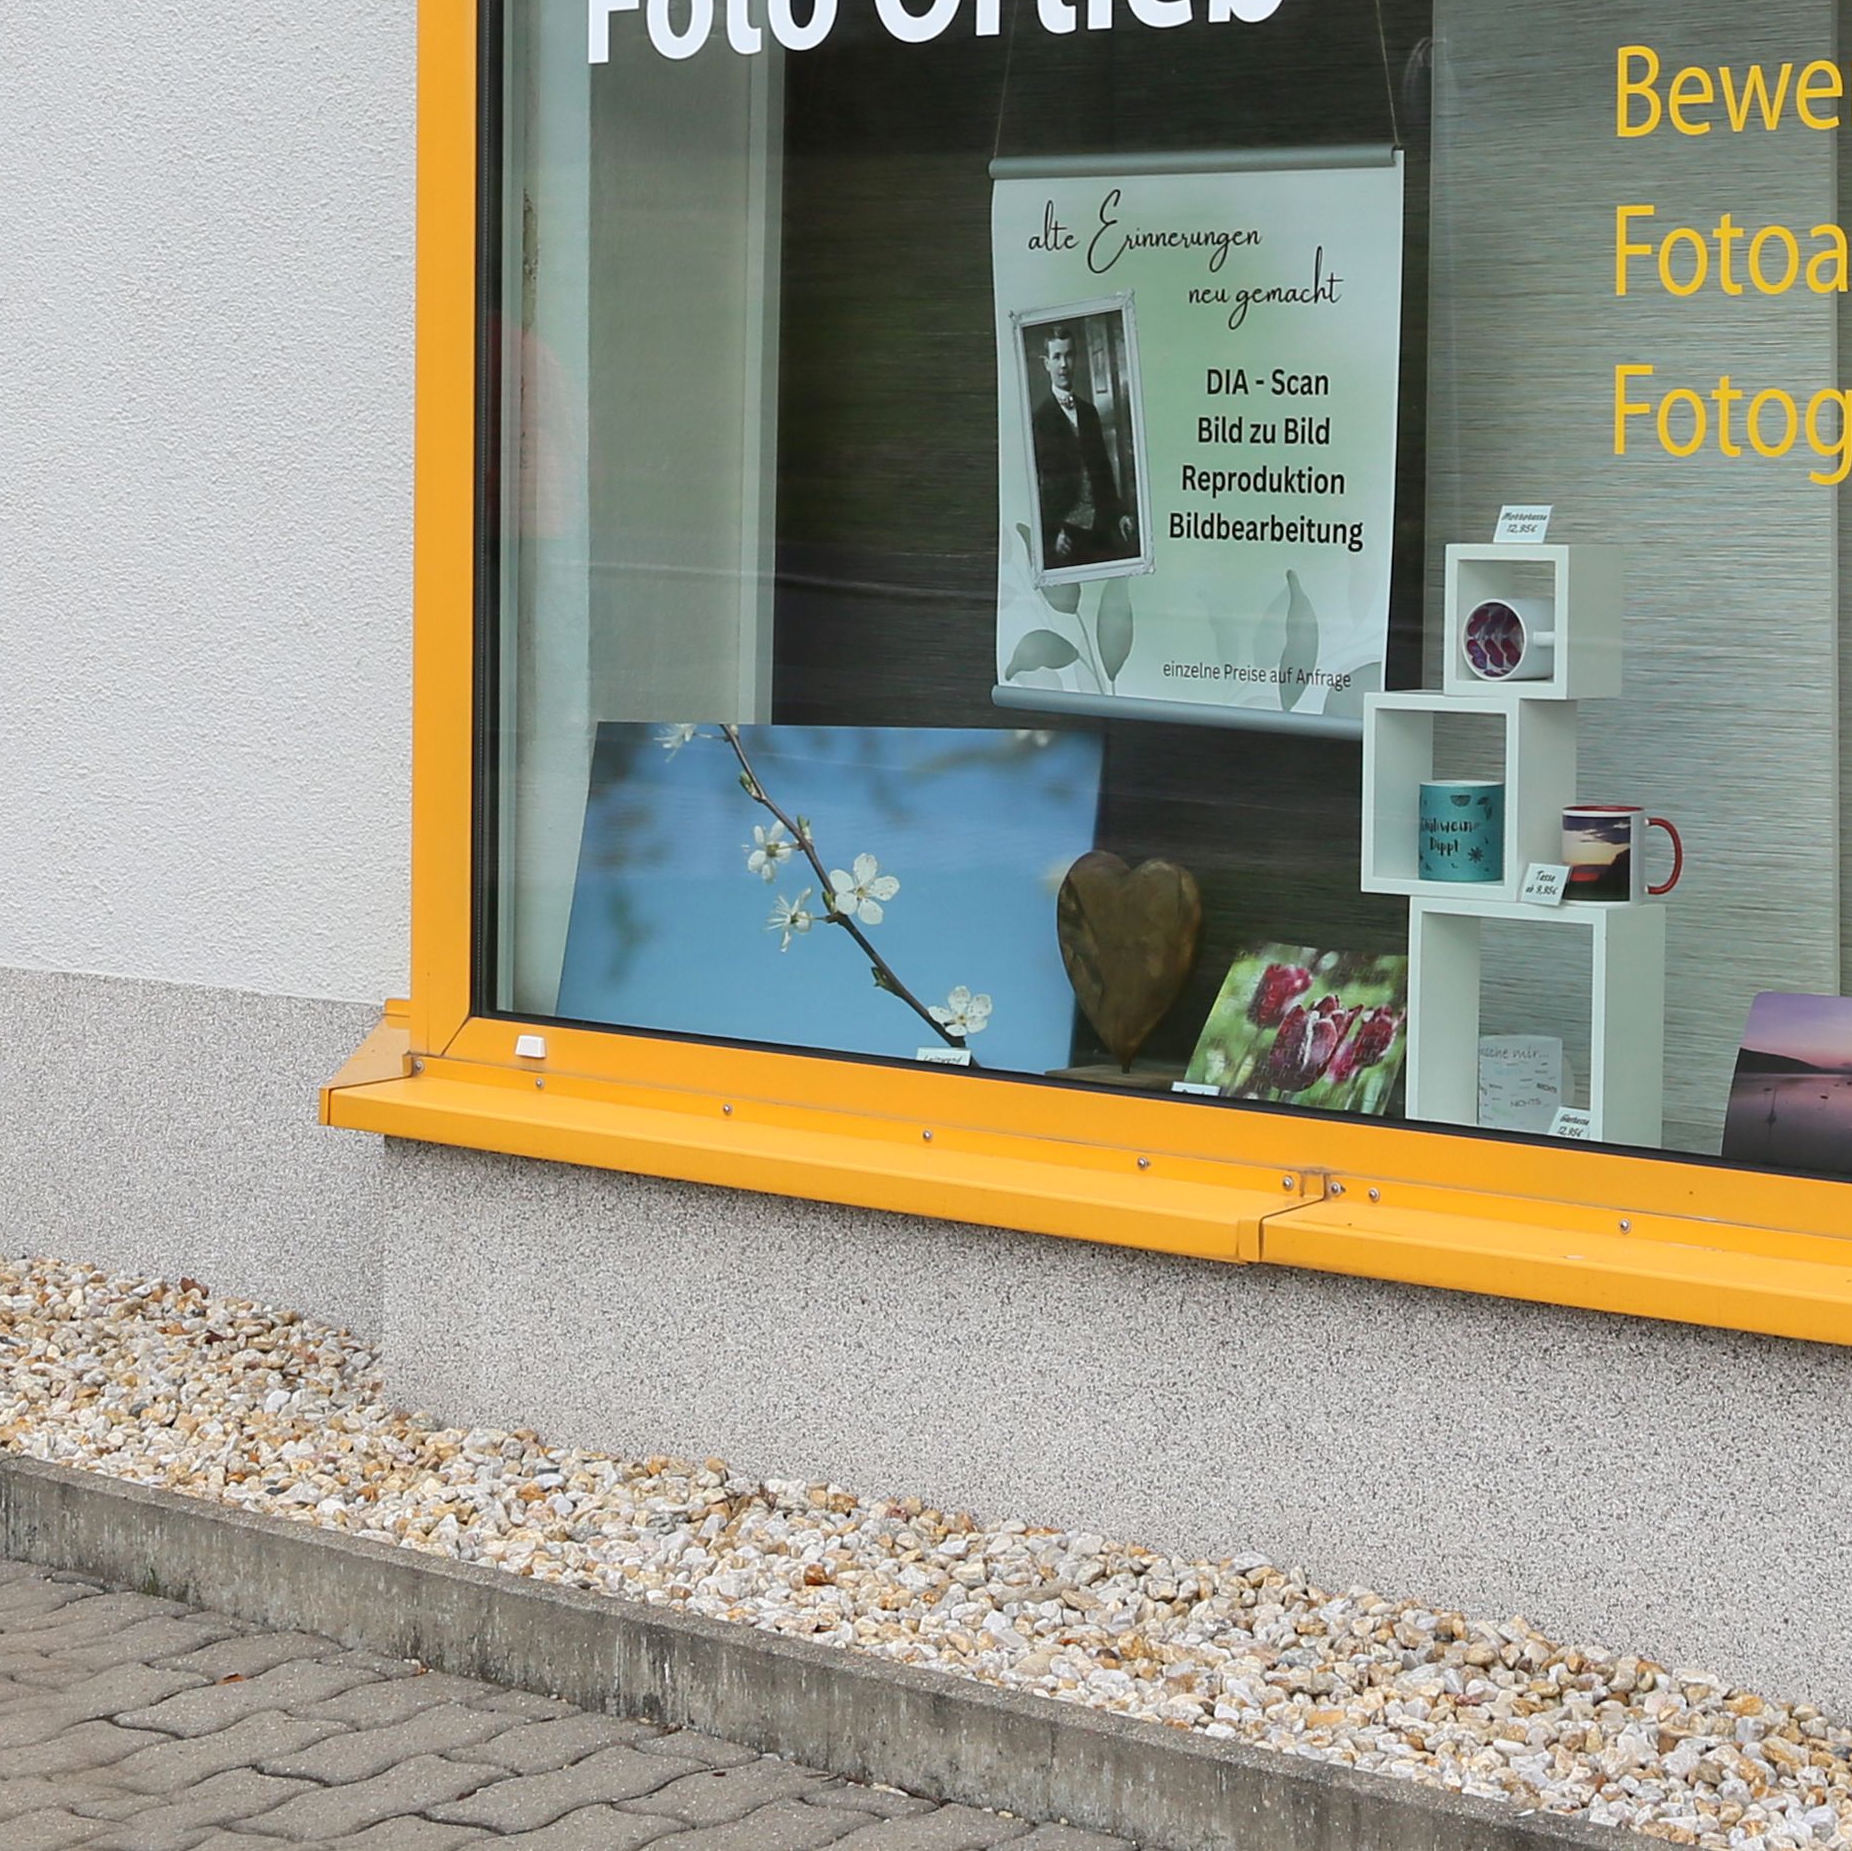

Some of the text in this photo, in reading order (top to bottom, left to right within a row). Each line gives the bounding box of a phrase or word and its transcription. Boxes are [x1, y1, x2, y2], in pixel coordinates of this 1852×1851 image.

[1028, 189, 1263, 274] alte Erinnerungen
[1188, 245, 1344, 330] neu gemacht
[1206, 369, 1249, 395] DIA
[1271, 369, 1329, 395] Scan
[1198, 416, 1330, 445] Bild zu Bild
[1182, 465, 1345, 499] Reproduktion
[1169, 512, 1364, 552] Bildbearbeitung
[1163, 660, 1351, 692] einzelne Preise auf Anfrage
[1536, 870, 1556, 882] Tasse
